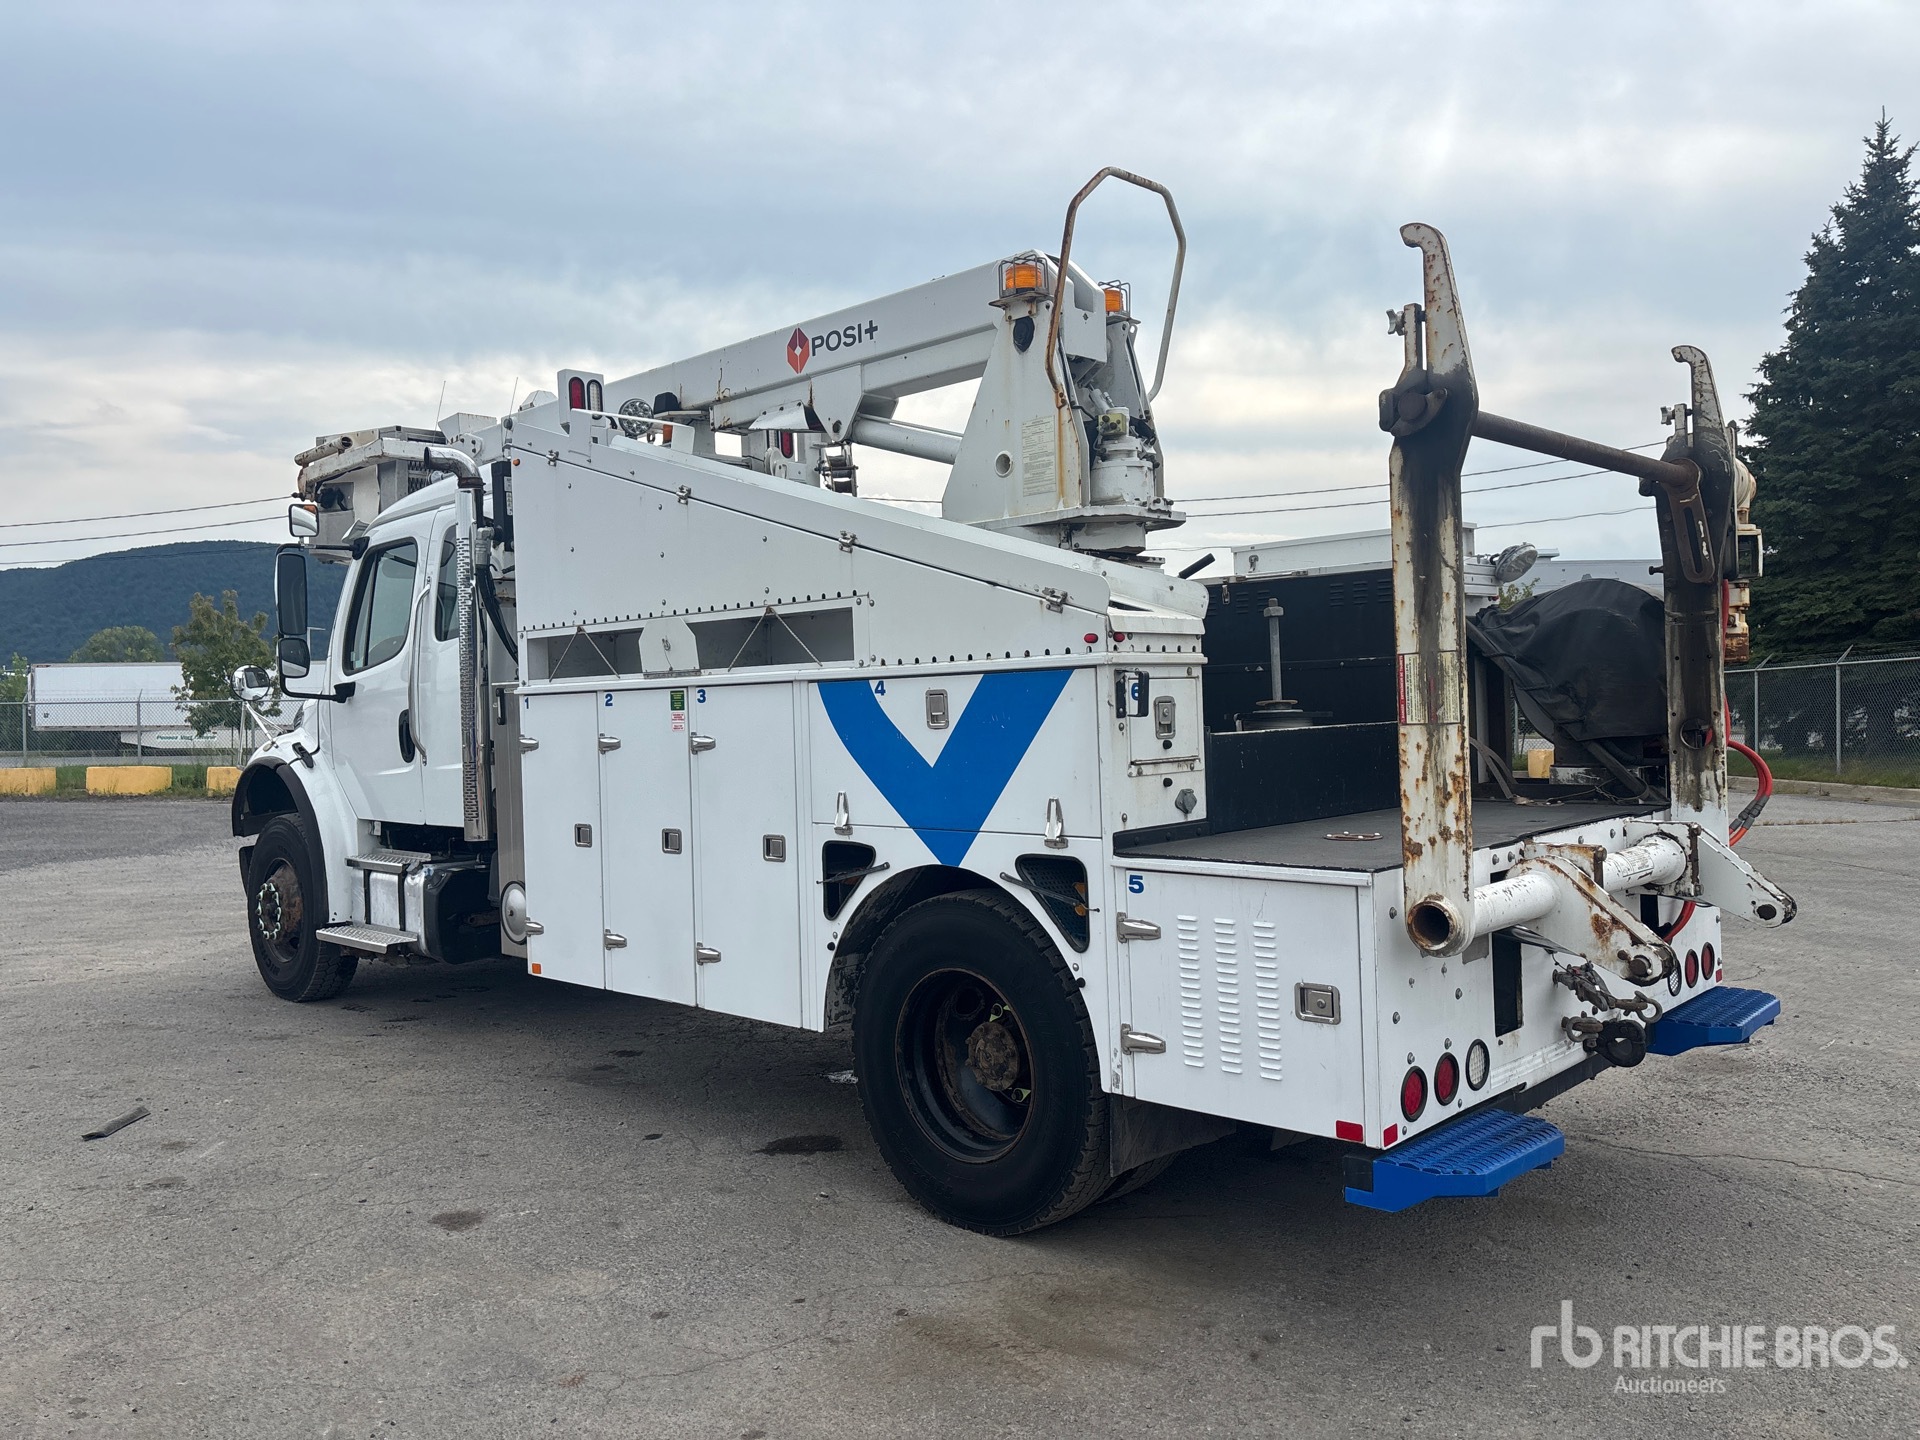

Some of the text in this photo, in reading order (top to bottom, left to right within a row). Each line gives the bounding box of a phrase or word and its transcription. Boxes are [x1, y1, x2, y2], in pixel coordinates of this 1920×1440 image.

[811, 319, 878, 357] POSI+
[874, 680, 886, 696] 4
[524, 697, 529, 709] 1
[605, 693, 613, 706] 2
[697, 689, 706, 703] 3
[1128, 874, 1144, 894] 5
